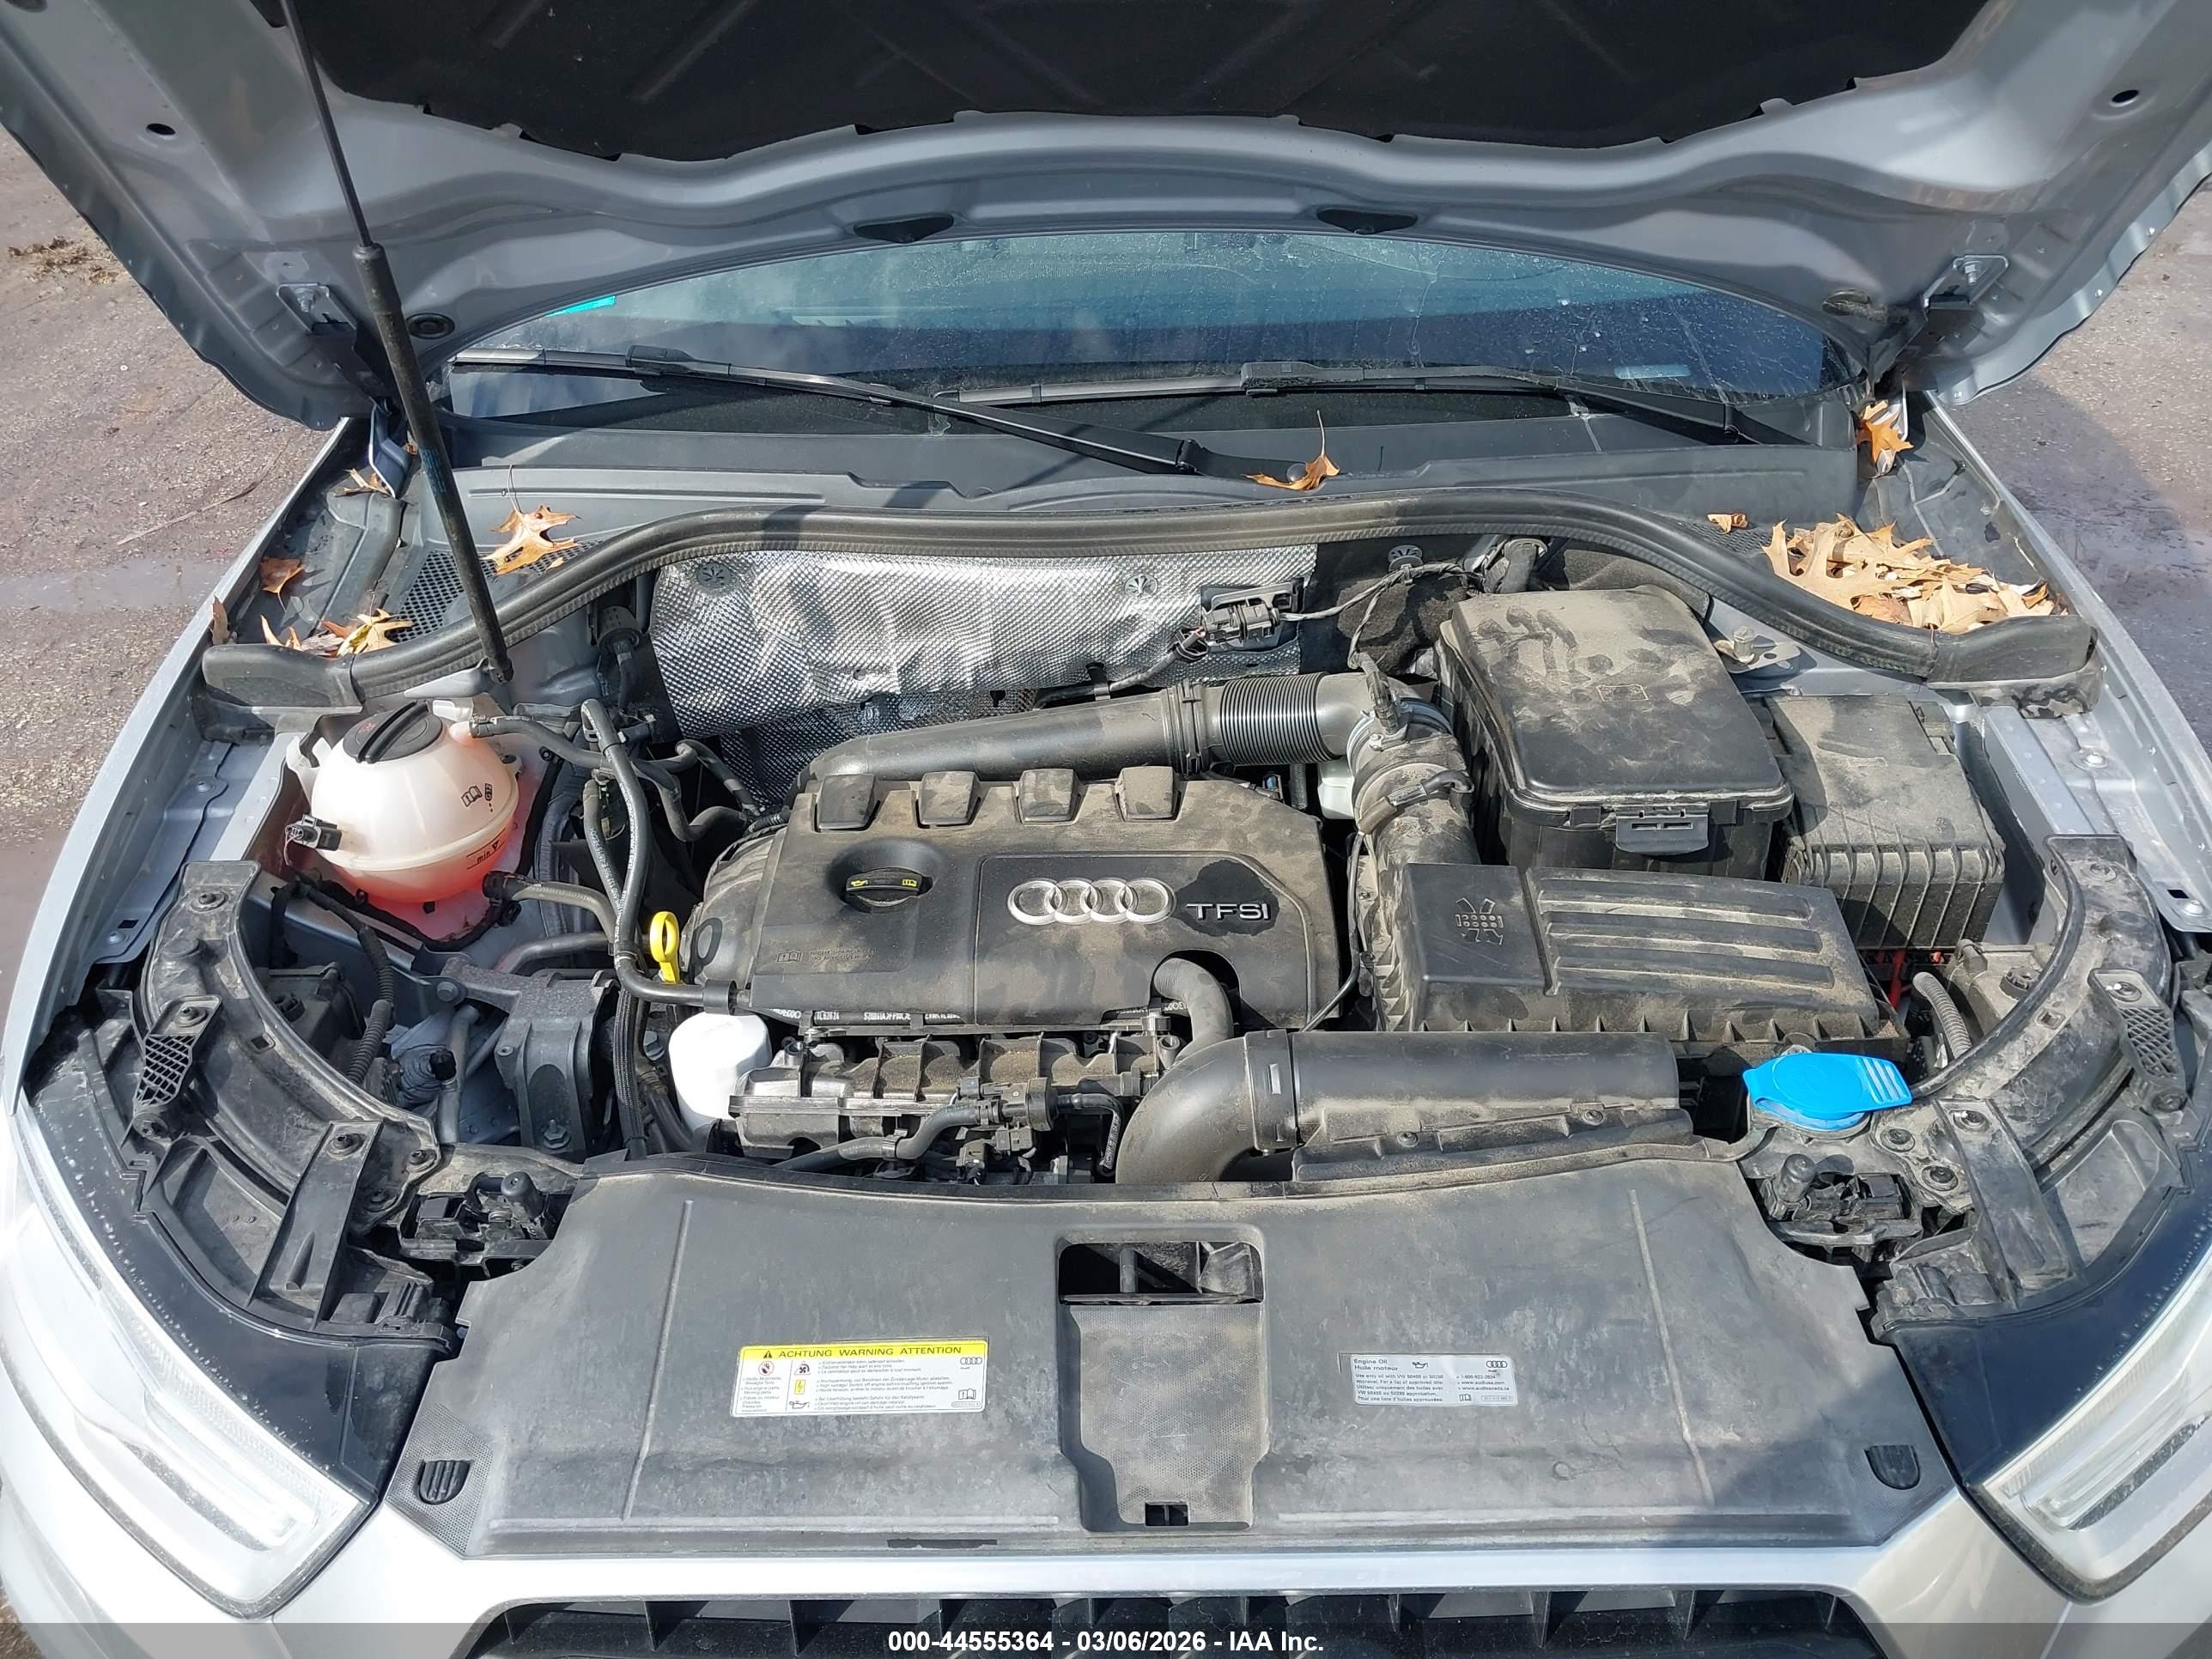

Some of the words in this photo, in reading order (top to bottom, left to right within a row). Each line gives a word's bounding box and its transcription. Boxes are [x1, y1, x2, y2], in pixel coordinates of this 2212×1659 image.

[477, 850, 490, 864] min
[1186, 902, 1270, 921] TFSI
[899, 1346, 962, 1355] ATTENTION
